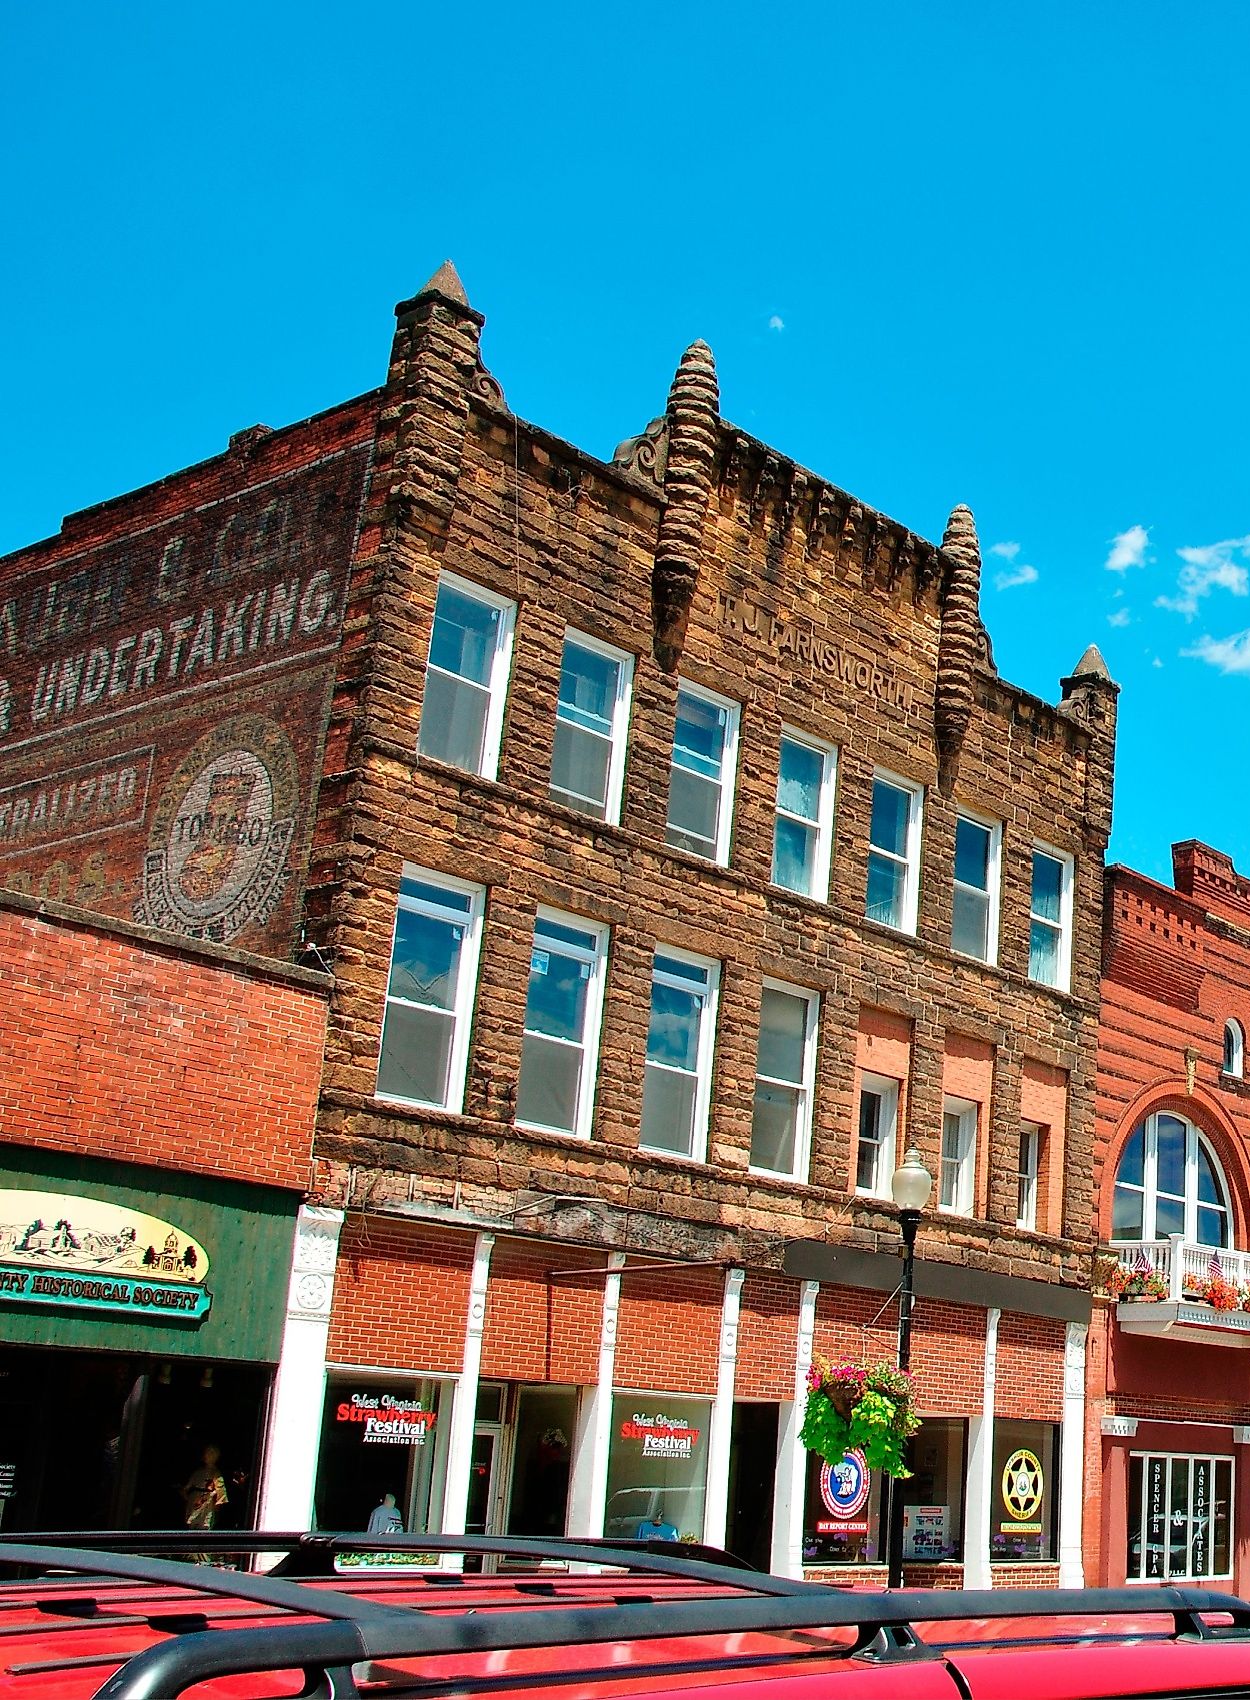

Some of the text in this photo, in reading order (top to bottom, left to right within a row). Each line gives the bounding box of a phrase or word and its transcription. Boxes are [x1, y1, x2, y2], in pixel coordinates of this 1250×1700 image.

[770, 617, 913, 708] FARNSWORTH
[32, 1276, 130, 1301] HISTORICAL
[133, 1287, 200, 1308] SOCIETY
[336, 1403, 436, 1431] Strawberry
[366, 1418, 425, 1435] Festival
[363, 1435, 410, 1445] Association
[620, 1422, 700, 1446] Strawberry
[644, 1434, 692, 1450] Festival
[642, 1449, 679, 1458] Association
[1024, 1451, 1041, 1472] COUNTY
[1153, 1463, 1161, 1533] SPENCER
[1011, 1508, 1033, 1519] SHERIFF
[1173, 1509, 1183, 1526] &
[1196, 1465, 1205, 1572] ASSOCIATES
